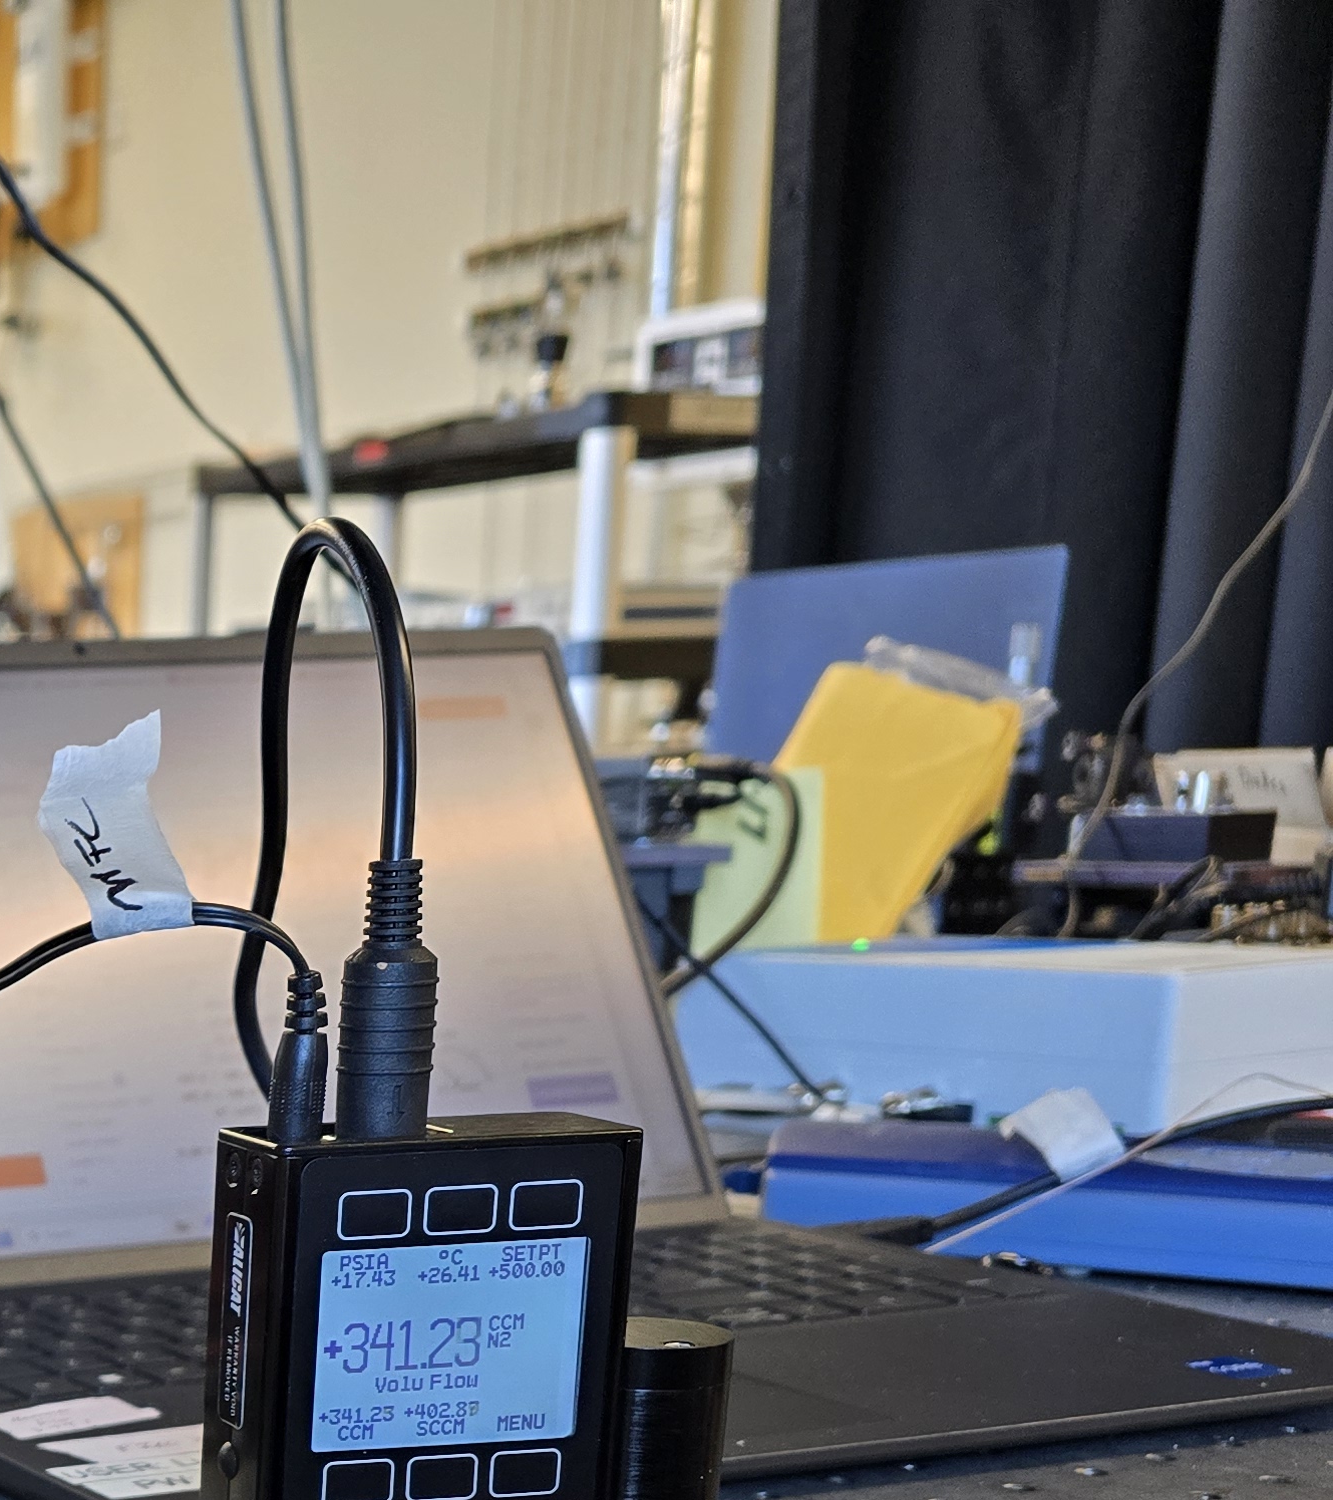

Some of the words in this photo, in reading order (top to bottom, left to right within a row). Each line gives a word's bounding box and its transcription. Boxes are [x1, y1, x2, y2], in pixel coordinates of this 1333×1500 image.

[340, 1253, 390, 1272] PSIA
[501, 1243, 562, 1262] SETPT
[331, 1270, 396, 1289] +17.43
[418, 1265, 480, 1284] +26.41
[489, 1260, 566, 1280] +500.00
[323, 1316, 483, 1374] +341.23
[488, 1313, 525, 1332] CCM
[487, 1332, 511, 1349] N2
[375, 1375, 424, 1393] Volu
[430, 1373, 479, 1391] Flow
[337, 1423, 375, 1442] CCM
[416, 1418, 465, 1438] SCCM
[497, 1413, 546, 1432] MENU
